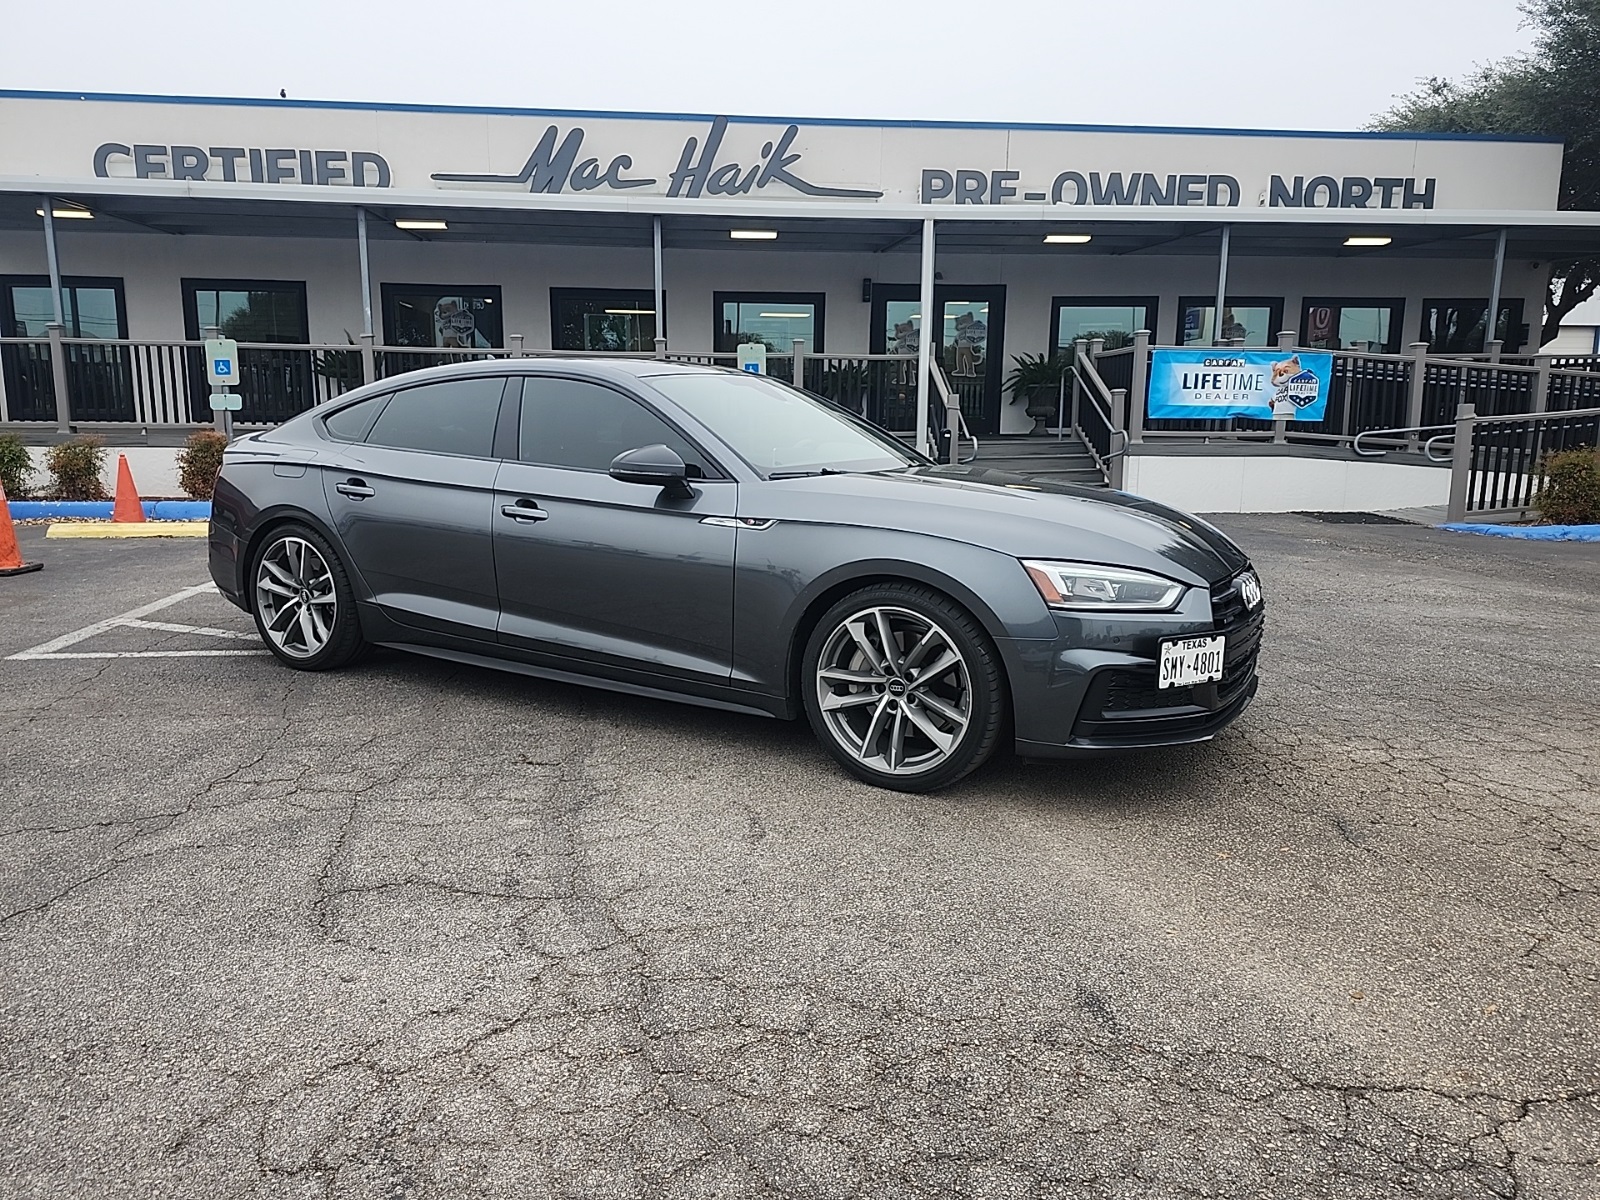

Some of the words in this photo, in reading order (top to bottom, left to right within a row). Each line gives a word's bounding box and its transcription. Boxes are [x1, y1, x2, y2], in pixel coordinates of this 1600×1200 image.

[93, 143, 391, 188] CERTIFIED
[431, 125, 656, 194] Mac
[665, 115, 884, 198] Haik
[921, 169, 1241, 207] PRE-OWNED
[1269, 174, 1437, 210] NORTH
[1204, 359, 1246, 367] CARFAX
[1182, 372, 1264, 391] LIFETIME
[1182, 639, 1207, 650] TEXAS
